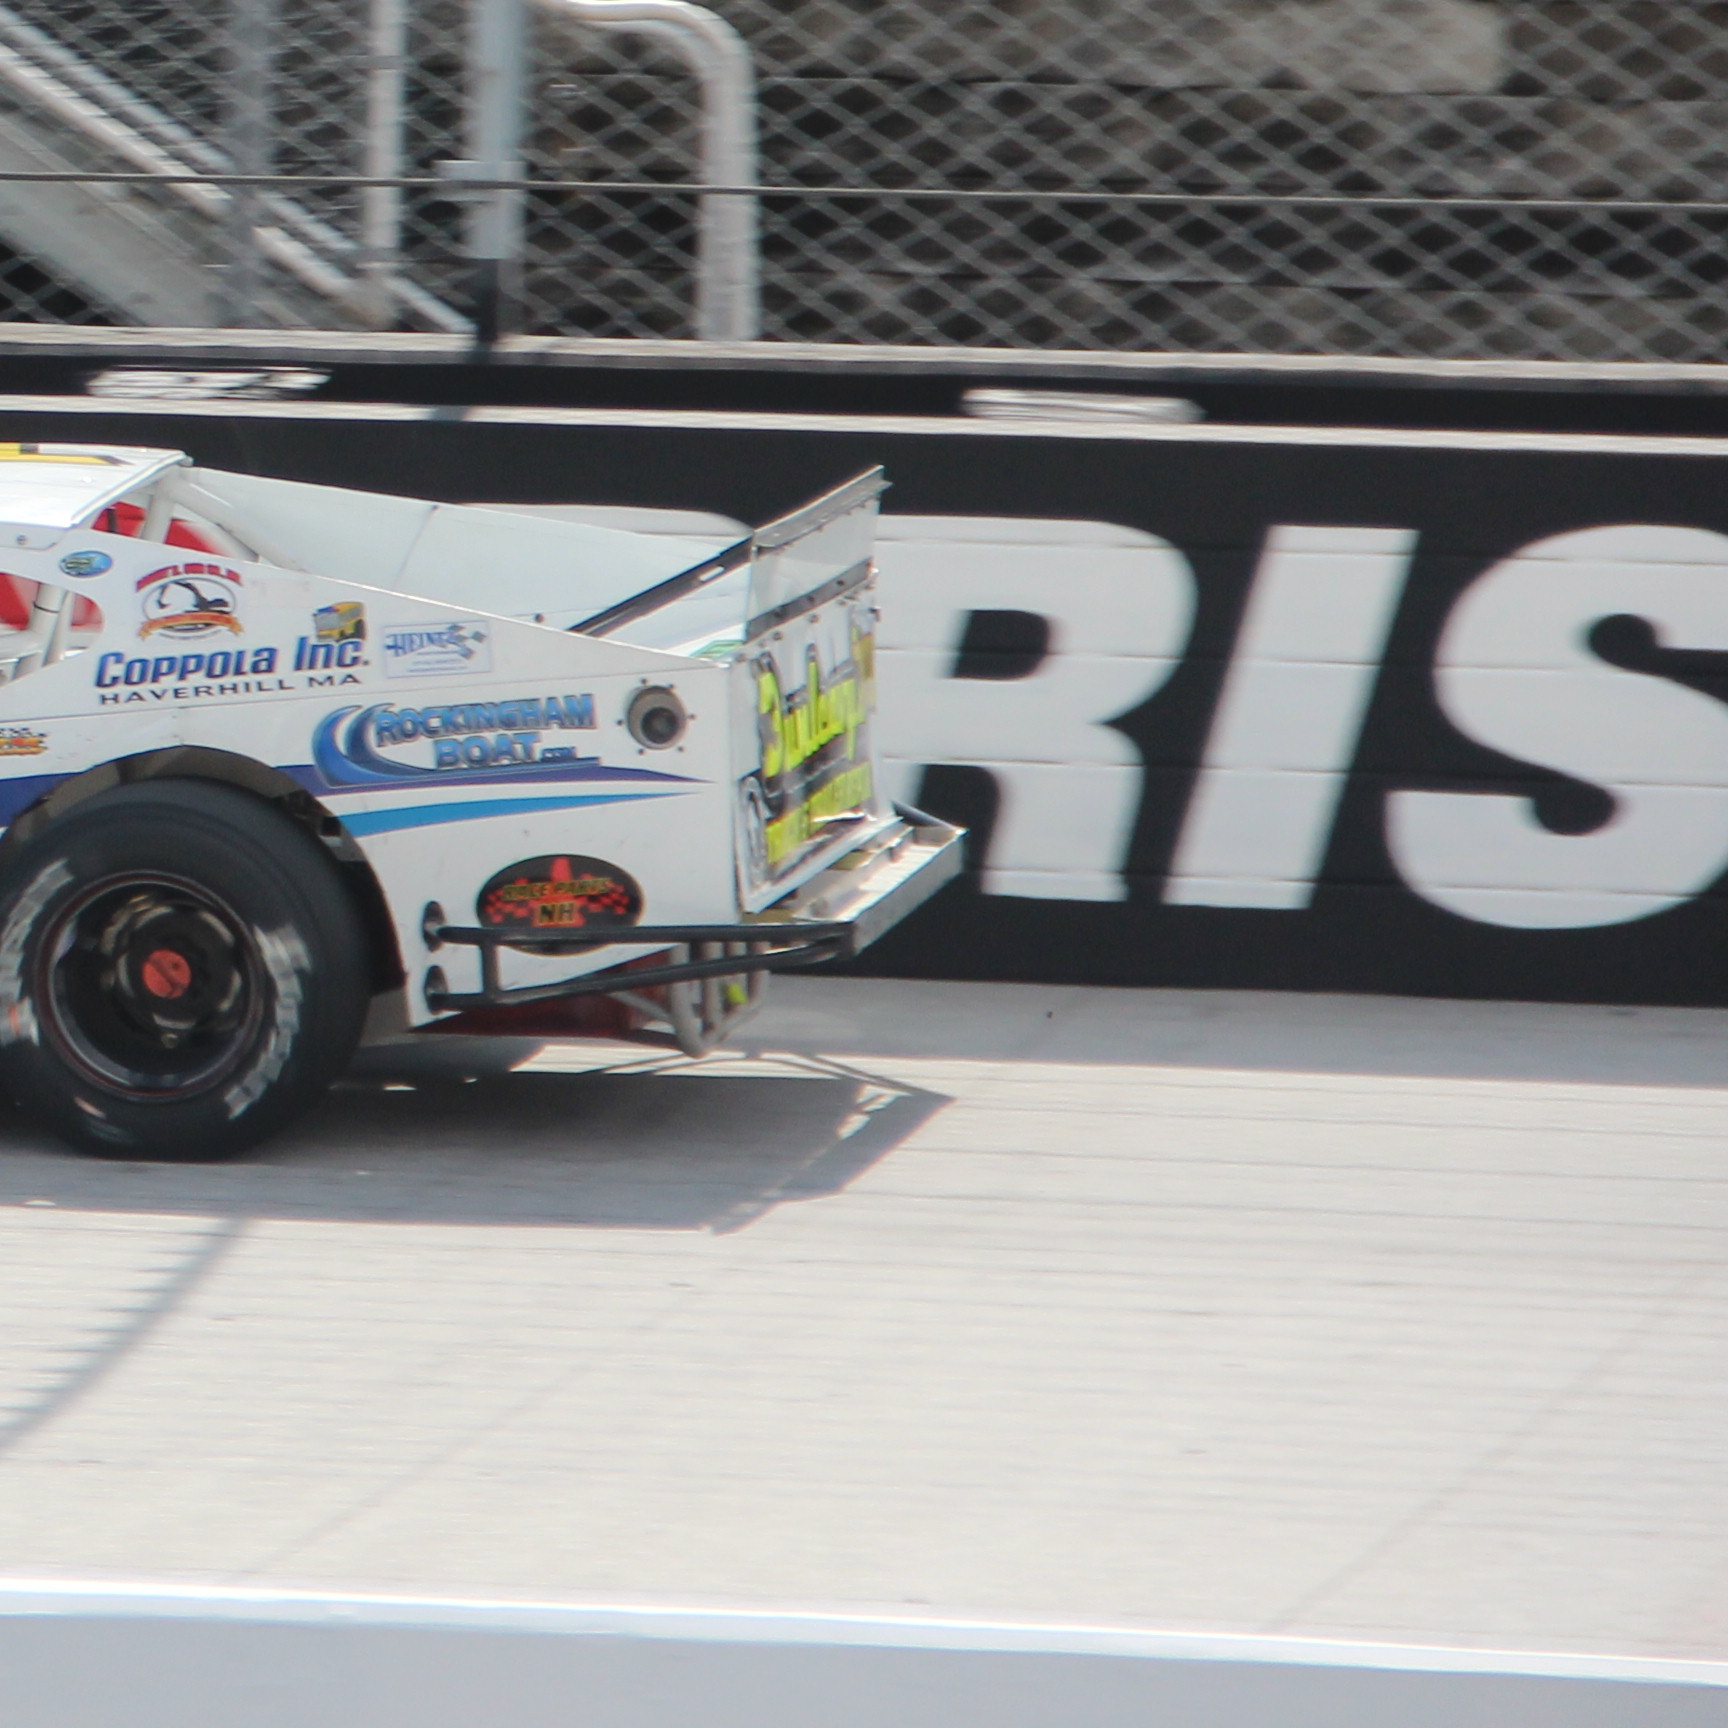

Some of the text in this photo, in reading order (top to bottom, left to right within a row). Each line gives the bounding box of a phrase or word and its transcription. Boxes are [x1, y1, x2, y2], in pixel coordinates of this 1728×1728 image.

[294, 637, 371, 671] Inc.
[99, 674, 362, 705] HAVERHILL MA
[374, 694, 596, 747] ROCKINGHAM
[452, 503, 1728, 929] RIS
[434, 732, 541, 769] BOAT
[538, 902, 575, 925] NH
